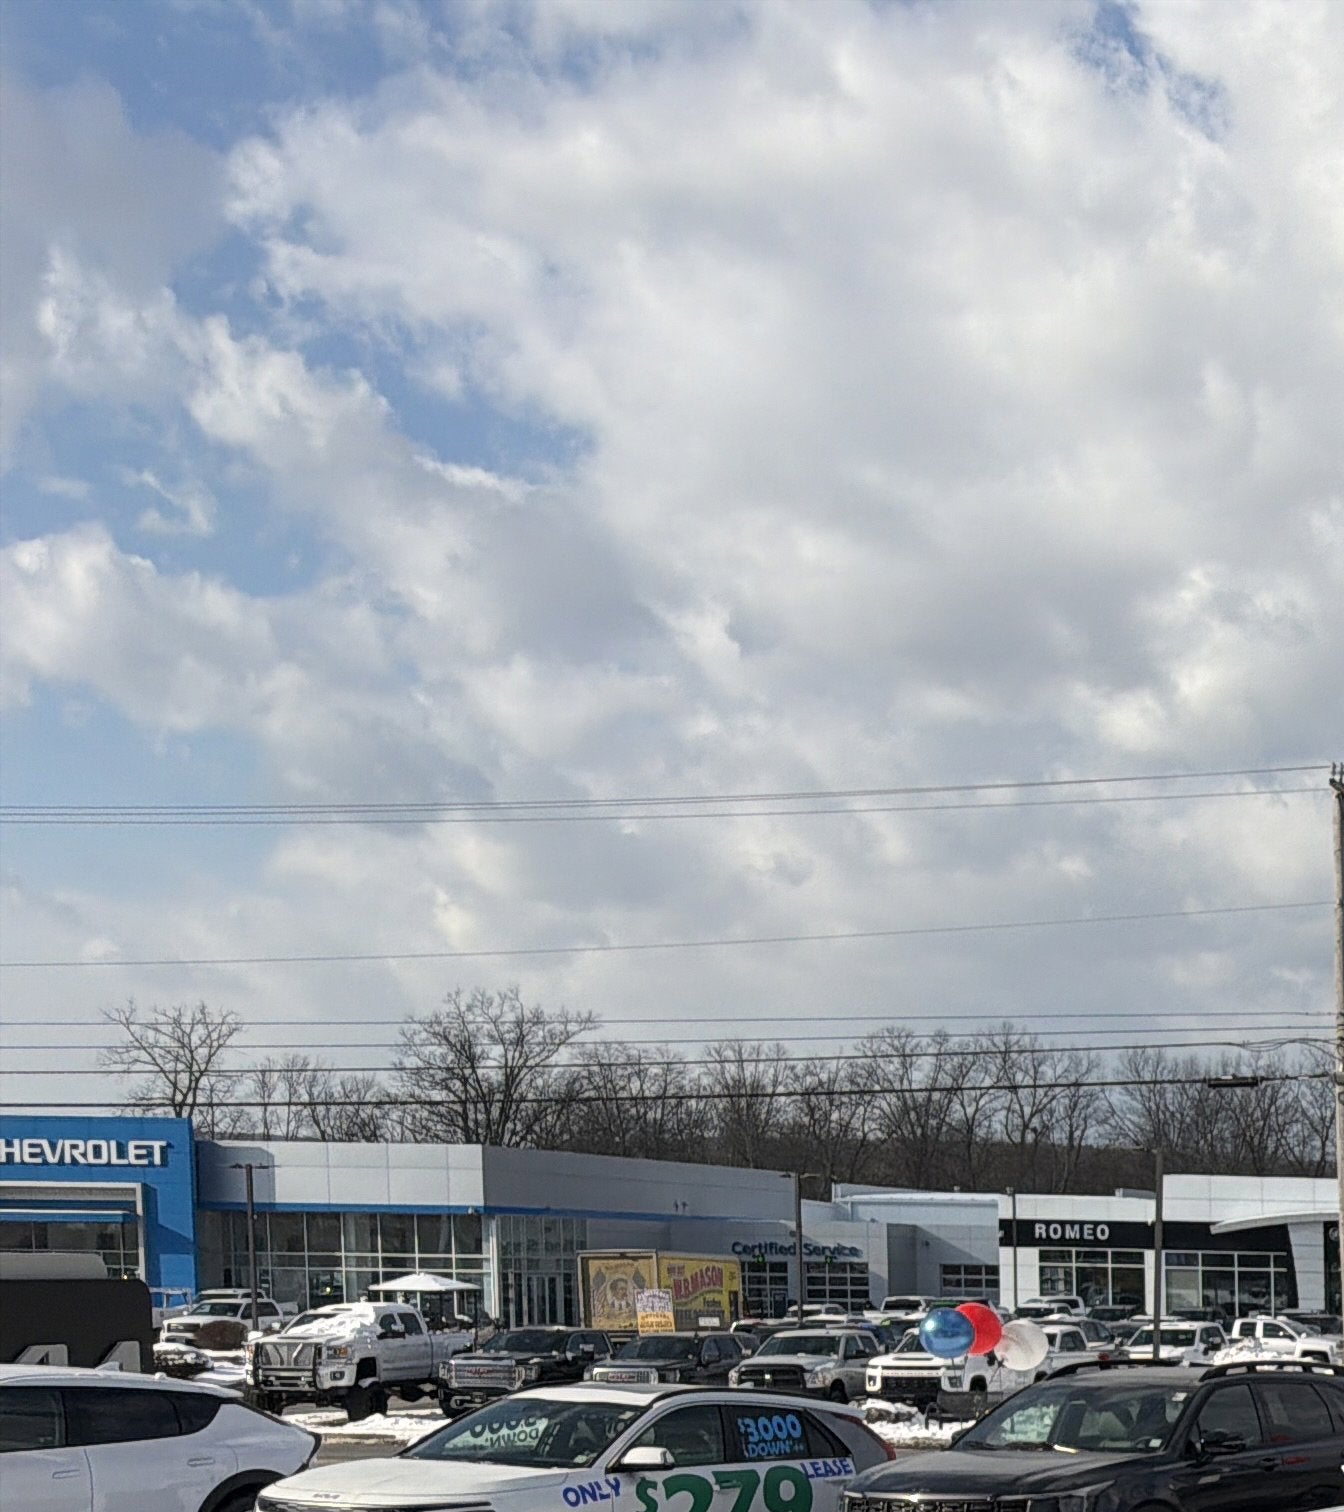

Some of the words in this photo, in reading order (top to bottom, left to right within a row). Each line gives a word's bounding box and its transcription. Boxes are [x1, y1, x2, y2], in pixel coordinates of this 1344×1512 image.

[0, 1138, 167, 1165] HEVROLET
[1035, 1223, 1110, 1240] ROMEO
[732, 1241, 797, 1256] Certified
[803, 1243, 861, 1257] Service
[801, 1460, 853, 1480] LEASE
[562, 1477, 621, 1508] ONLY
